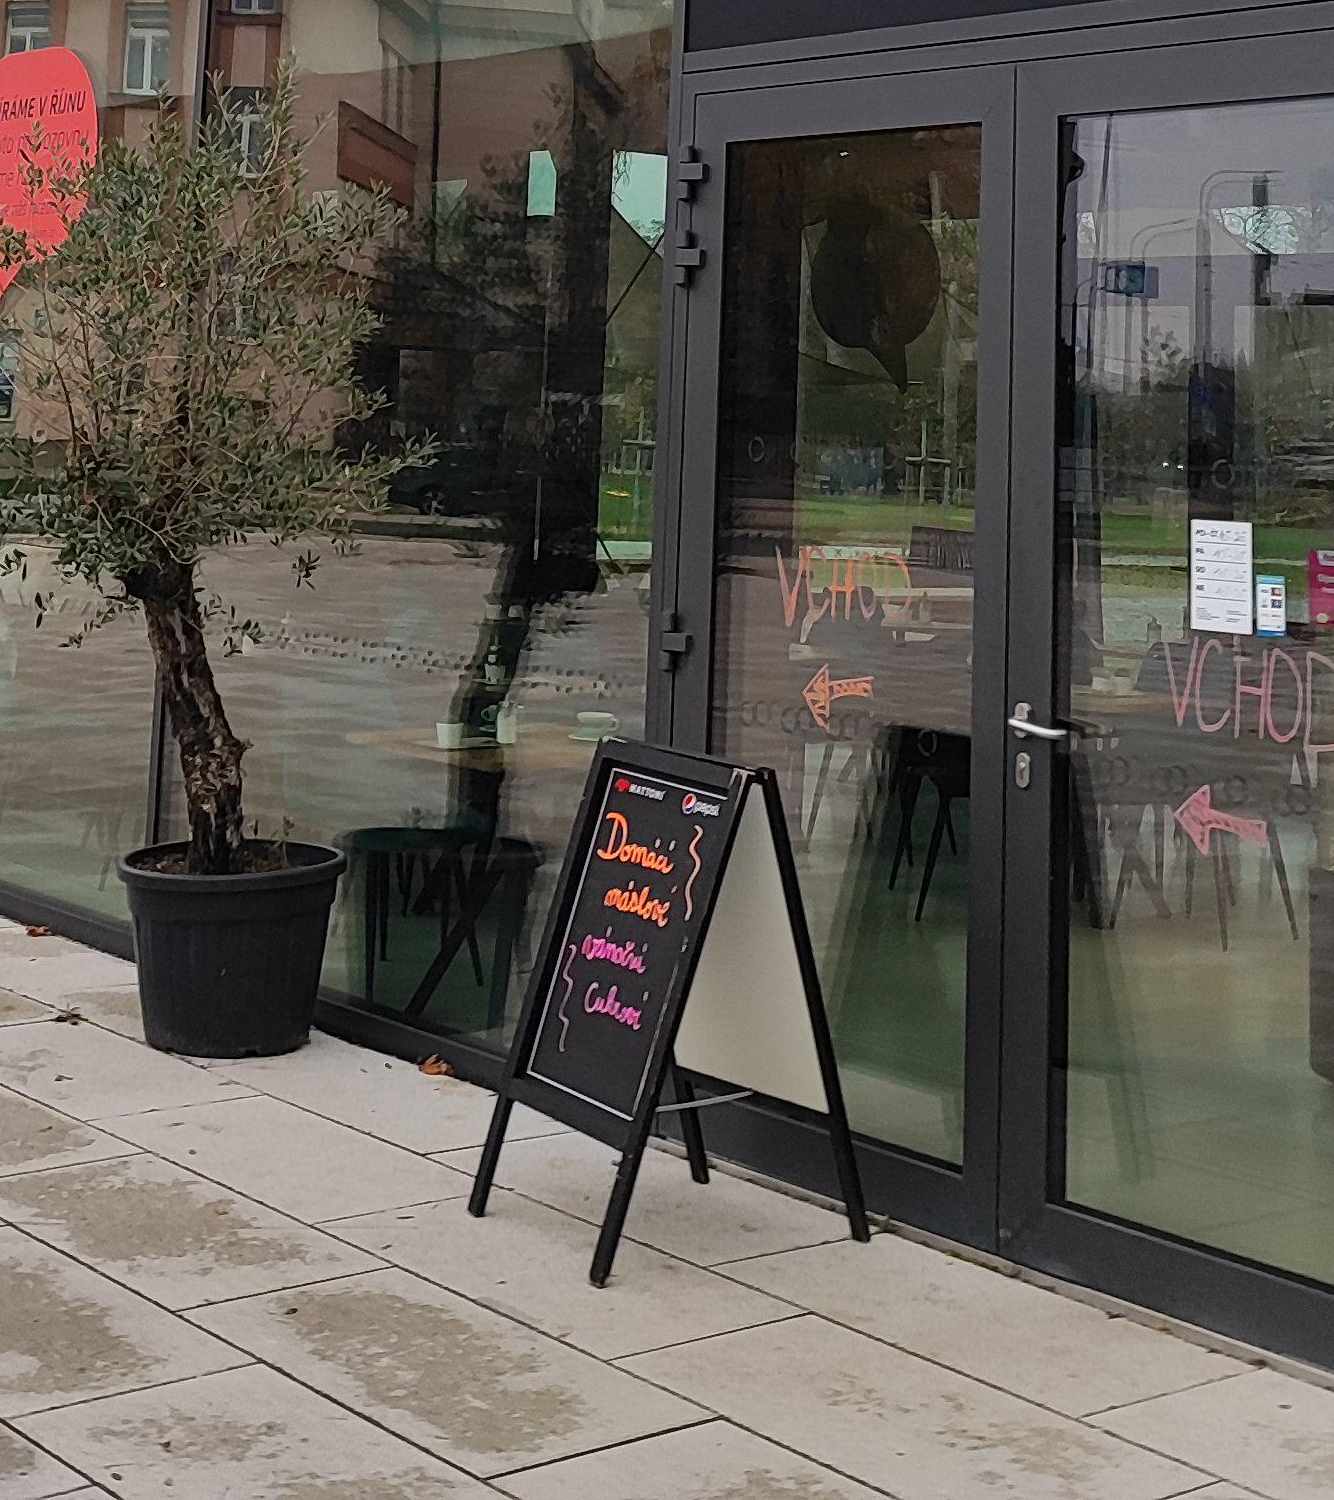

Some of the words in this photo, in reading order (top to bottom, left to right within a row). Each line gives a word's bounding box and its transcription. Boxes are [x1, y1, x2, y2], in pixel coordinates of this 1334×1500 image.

[39, 96, 48, 117] V
[49, 87, 87, 116] ŘÍJNU
[775, 543, 911, 628] VCHOD
